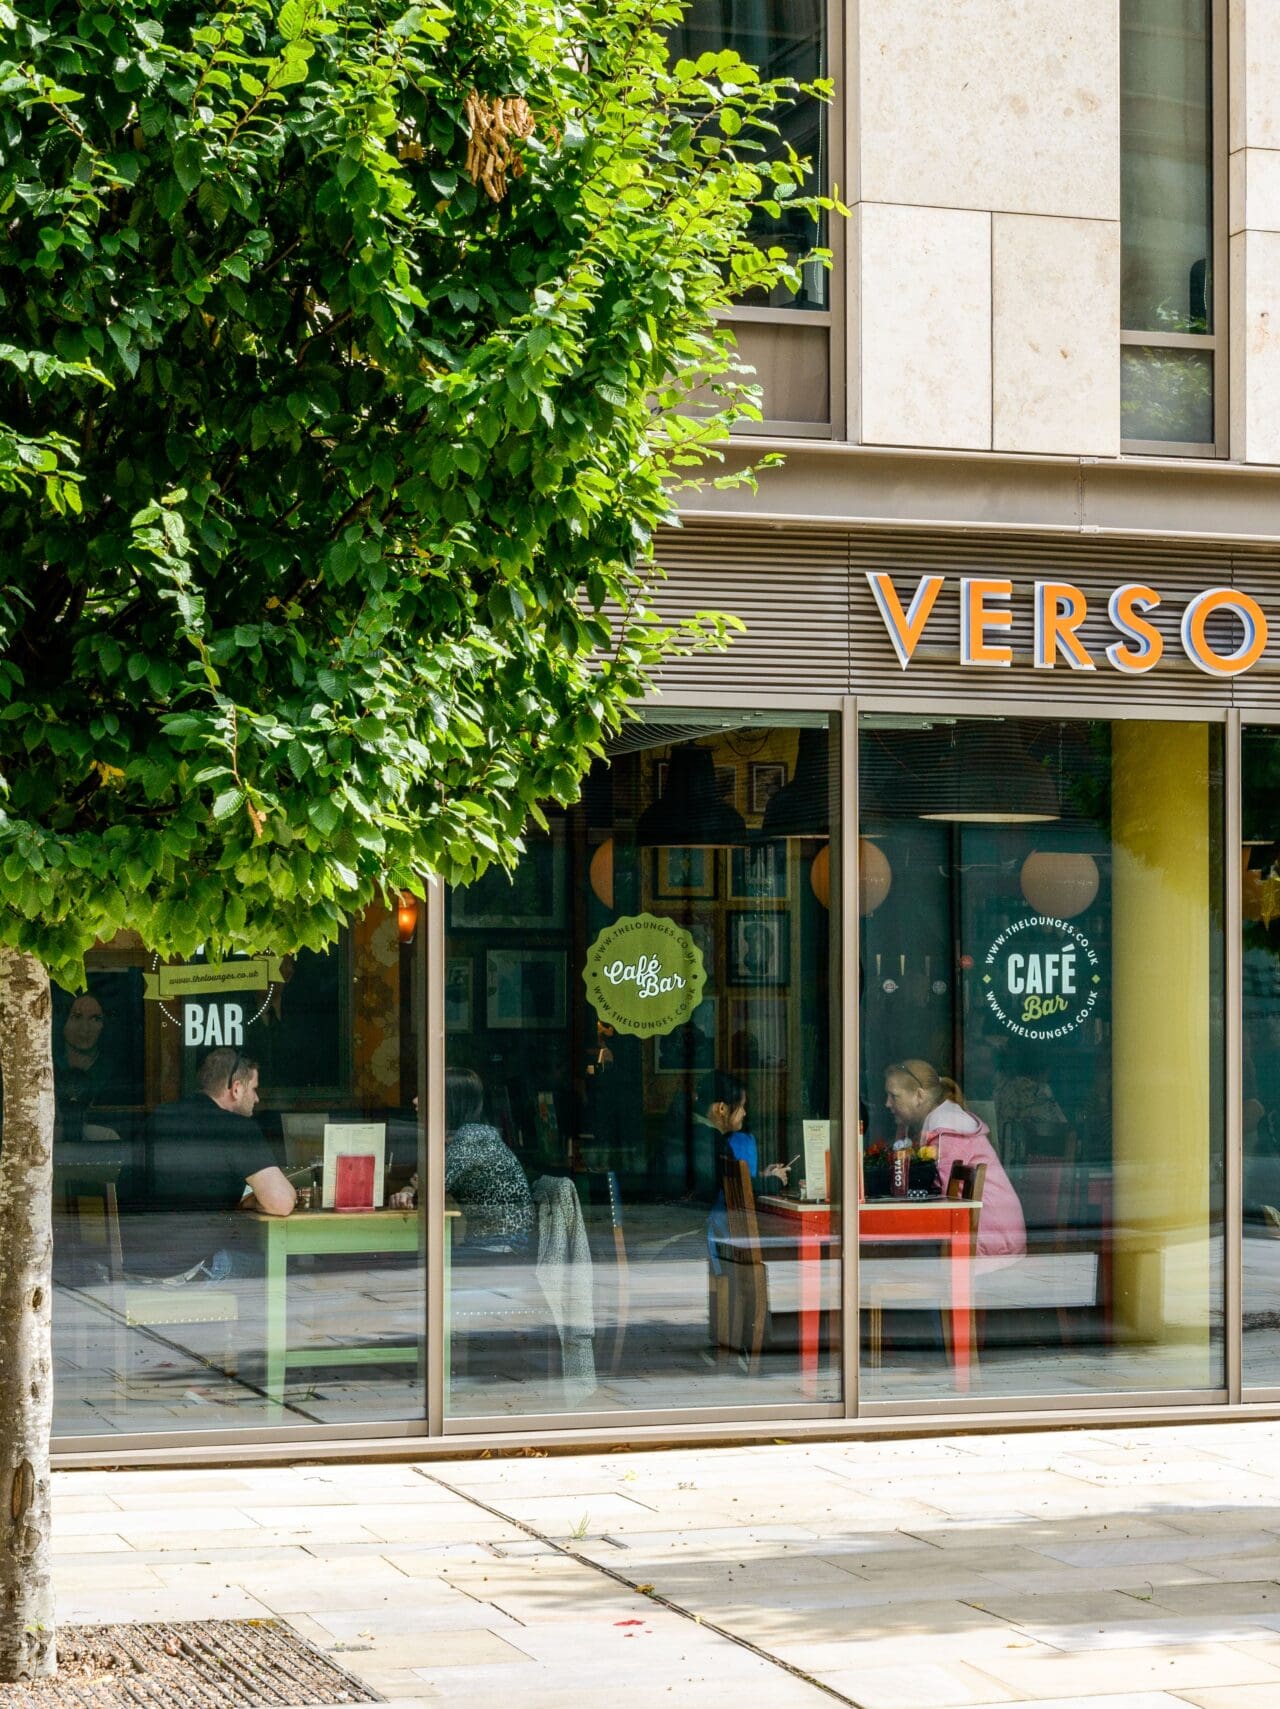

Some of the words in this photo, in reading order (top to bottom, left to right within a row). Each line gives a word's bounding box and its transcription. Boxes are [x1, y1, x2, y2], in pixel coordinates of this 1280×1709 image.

[865, 571, 1268, 677] VERSO
[594, 921, 697, 965] WWW.THELOUNGES.CO.UK
[985, 917, 1099, 966] WWW.THELOUNGES.CO.UK
[168, 969, 260, 986] www.thelounges.co.uk
[603, 954, 662, 987] Café
[639, 973, 687, 998] Bar
[1008, 943, 1077, 994] CAFÉ
[184, 1003, 244, 1046] BAR
[594, 985, 697, 1030] WWW.THELOUNGES.CO.UK
[985, 990, 1099, 1041] WWW.THELOUNGES.CO.UK
[1021, 994, 1069, 1022] Bar
